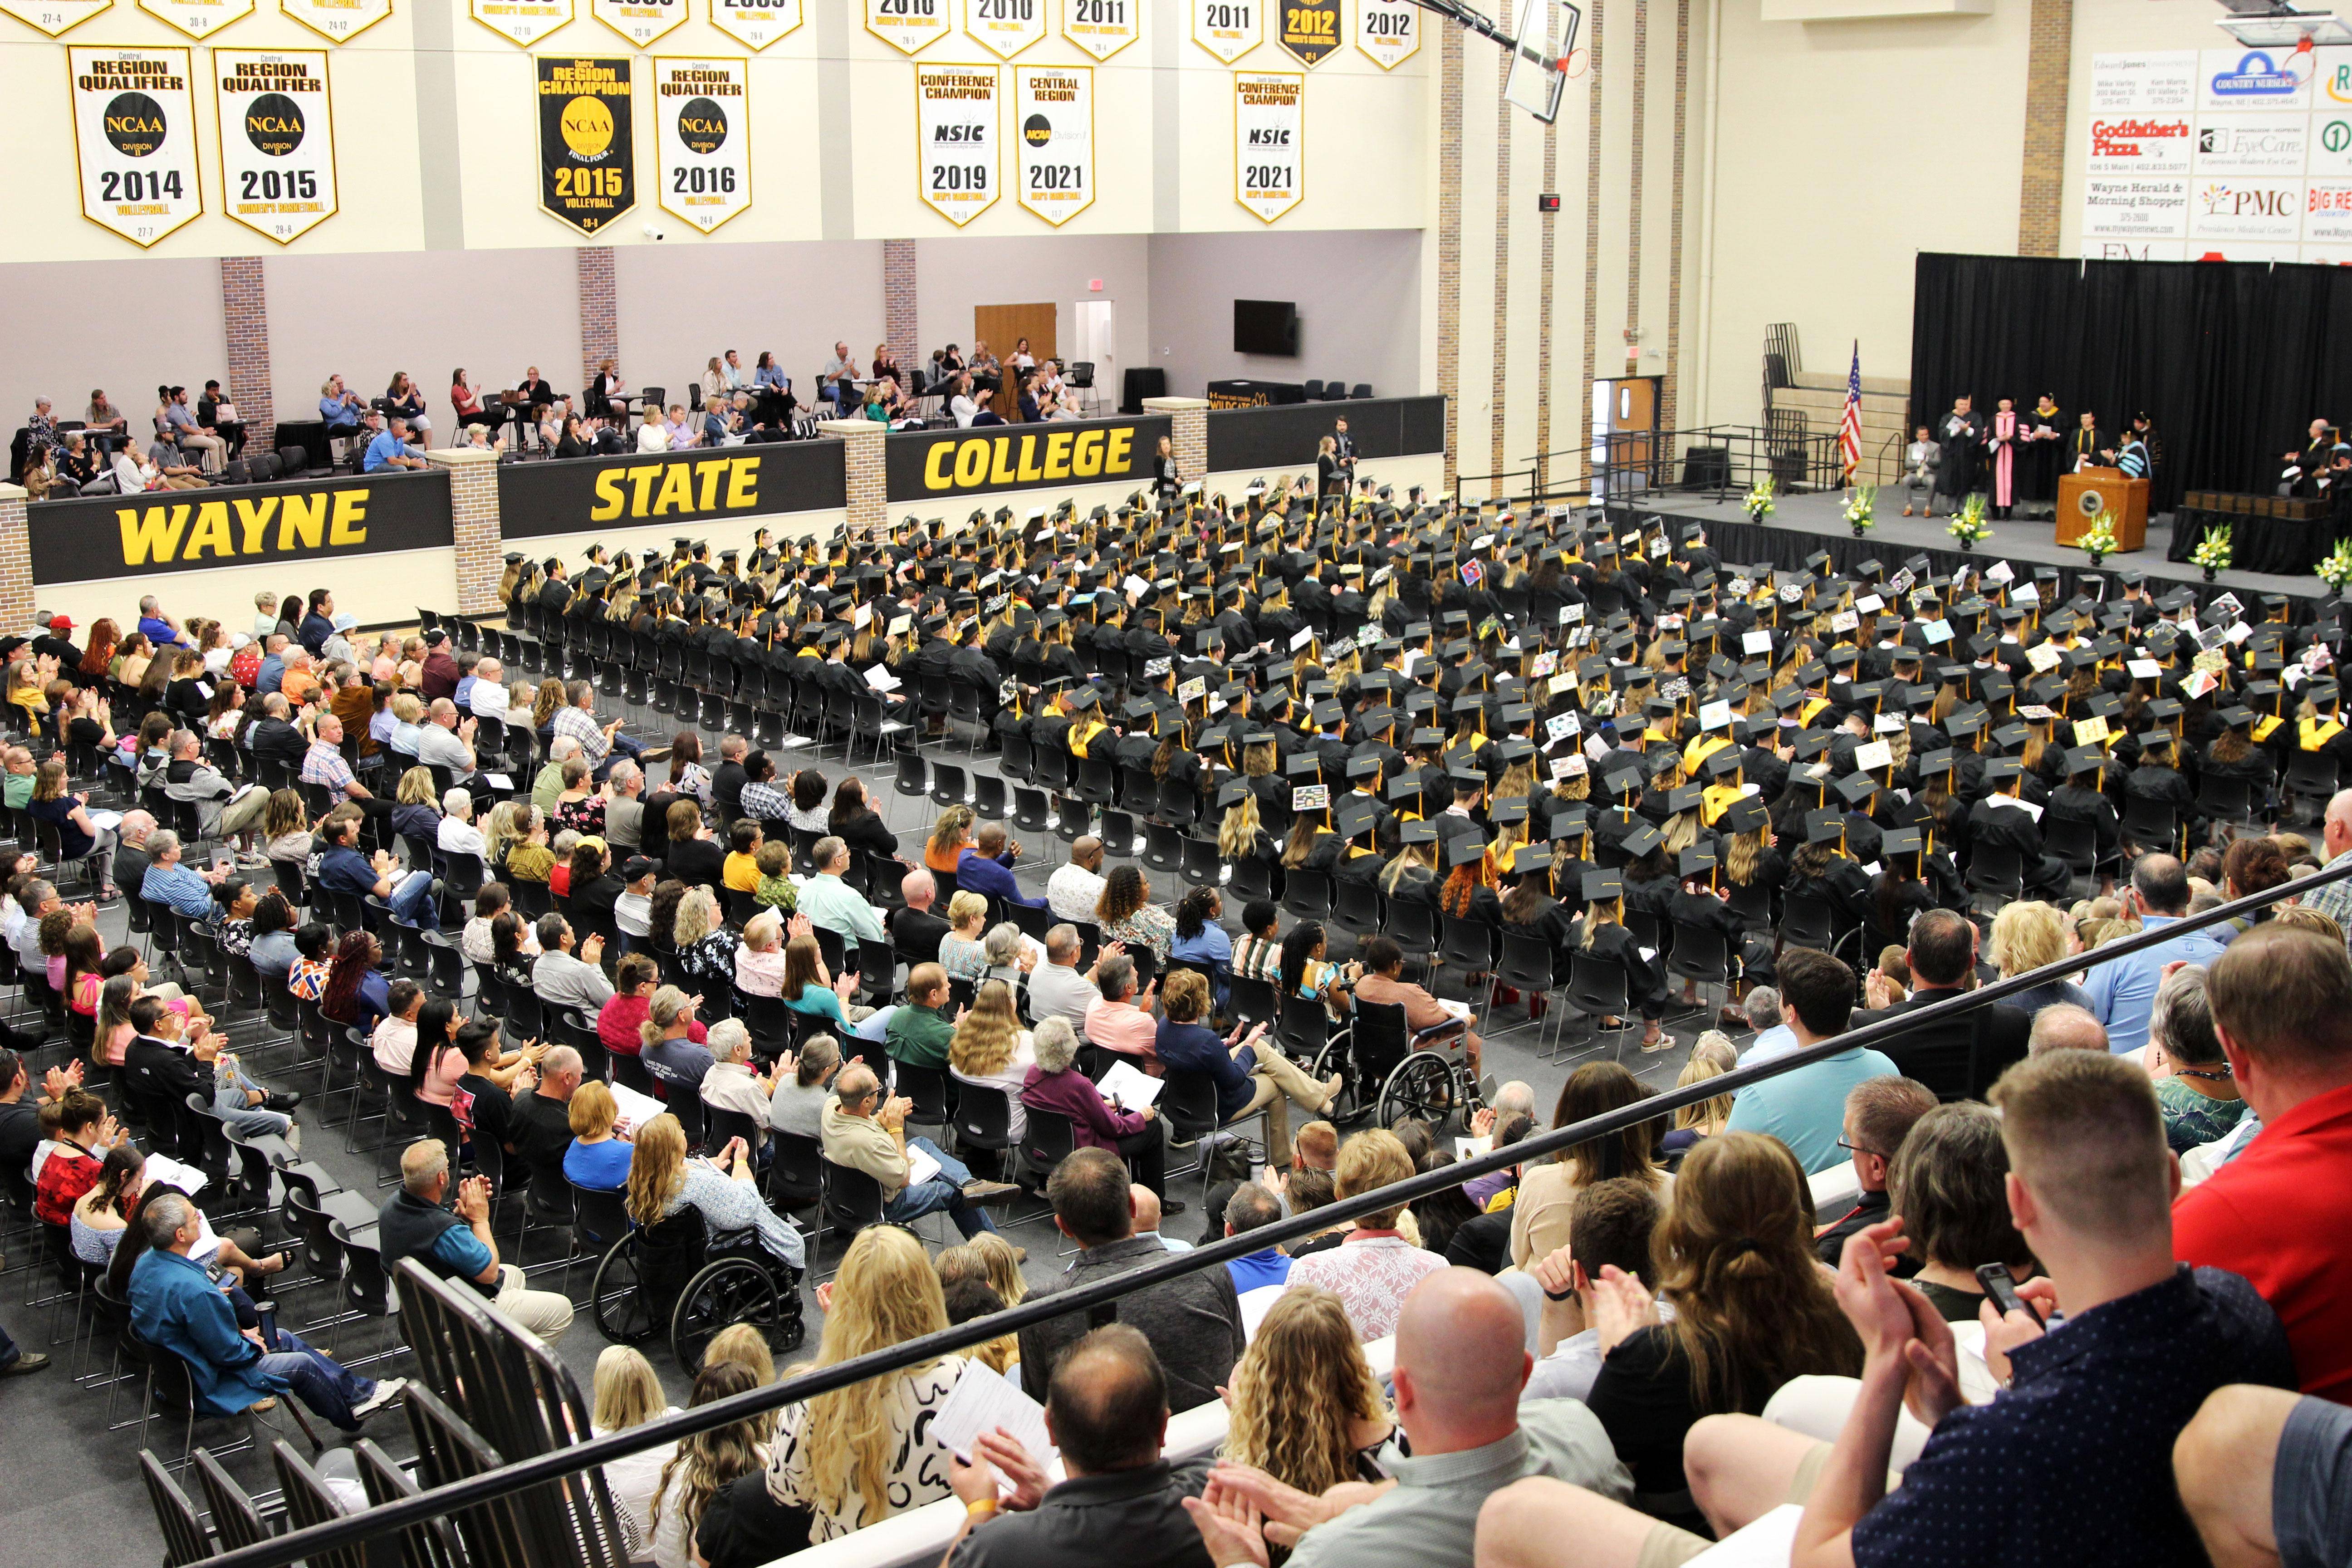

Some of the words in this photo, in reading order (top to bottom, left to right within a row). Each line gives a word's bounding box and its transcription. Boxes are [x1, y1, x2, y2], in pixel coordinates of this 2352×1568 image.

[483, 5, 517, 15] WOMEN'S
[519, 5, 562, 16] BASKETBALL
[620, 7, 664, 18] VOLLEYBALL
[735, 11, 777, 20] VOLLEYBALL
[979, 0, 1033, 20] 2010
[1076, 0, 1124, 23] 2011
[1207, 4, 1249, 28] 2011
[43, 14, 61, 24] 27-4
[190, 18, 207, 27] 30-8
[329, 21, 347, 30] 24-12
[875, 16, 903, 25] WOMEN'S
[906, 17, 940, 27] BASKETBALL
[1287, 8, 1336, 34] 2012
[1367, 12, 1410, 35] 2012
[988, 22, 1024, 31] VOLLEYBALL
[1070, 24, 1097, 34] WOMEN'S
[1098, 26, 1130, 35] BASKETBALL
[119, 52, 142, 60] Central
[92, 61, 167, 74] REGION
[236, 63, 307, 77] REGION
[574, 60, 594, 68] Central
[2122, 59, 2146, 69] Jones
[553, 67, 616, 81] REGION
[671, 70, 730, 82] REGION
[78, 75, 183, 92] QUALIFIER
[223, 77, 321, 93] QUALIFIER
[539, 80, 631, 95] CHAMPION
[921, 75, 995, 87] CONFERENCE
[1030, 78, 1079, 89] CENTRAL
[2216, 79, 2254, 89] COUNTRY
[661, 83, 742, 97] QUALIFIER
[926, 88, 991, 100] CHAMPION
[1239, 82, 1300, 94] CONFERENCE
[1035, 90, 1075, 101] REGION
[1244, 94, 1296, 106] CHAMPION
[106, 117, 164, 132] NCAA
[248, 116, 302, 132] NCAA
[565, 119, 610, 132] NCAA
[681, 118, 725, 133] NCAA
[2093, 119, 2188, 137] Godfather's
[935, 125, 985, 141] NSIC
[1026, 129, 1050, 140] NCAA
[1054, 131, 1082, 140] Division
[1250, 129, 1290, 144] NSIC
[2092, 139, 2142, 156] Pizza
[568, 150, 589, 162] FINAL
[591, 150, 609, 163] FOUR
[555, 167, 622, 196] 2015
[674, 167, 735, 193] 2016
[933, 165, 986, 189] 2019
[1030, 165, 1081, 189] 2021
[1247, 166, 1291, 188] 2021
[101, 170, 183, 201] 2014
[241, 170, 316, 200] 2015
[2091, 183, 2129, 194] Wayne
[2131, 183, 2170, 192] Herald
[2173, 183, 2183, 192] &
[684, 196, 727, 206] VOLLEYBALL
[933, 192, 951, 201] MEN'S
[953, 192, 987, 201] BASKETBALL
[1031, 192, 1048, 201] MEN'S
[1049, 191, 1081, 200] BASKETBALL
[2087, 196, 2136, 207] Morning
[2138, 196, 2185, 207] Shopper
[2309, 189, 2330, 212] BIG
[2335, 192, 2352, 210] RE
[116, 203, 171, 216] VOLLEYBALL
[237, 203, 276, 214] WOMEN'S
[278, 201, 325, 213] BASKETBALL
[565, 198, 614, 208] VOLLEYBALL
[2234, 190, 2295, 216] PMC
[138, 227, 153, 236] 27-7
[1210, 400, 1251, 410] WILDCATS
[924, 426, 1135, 490] COLLEGE
[591, 456, 761, 521] STATE
[116, 489, 369, 565] WAYNE
